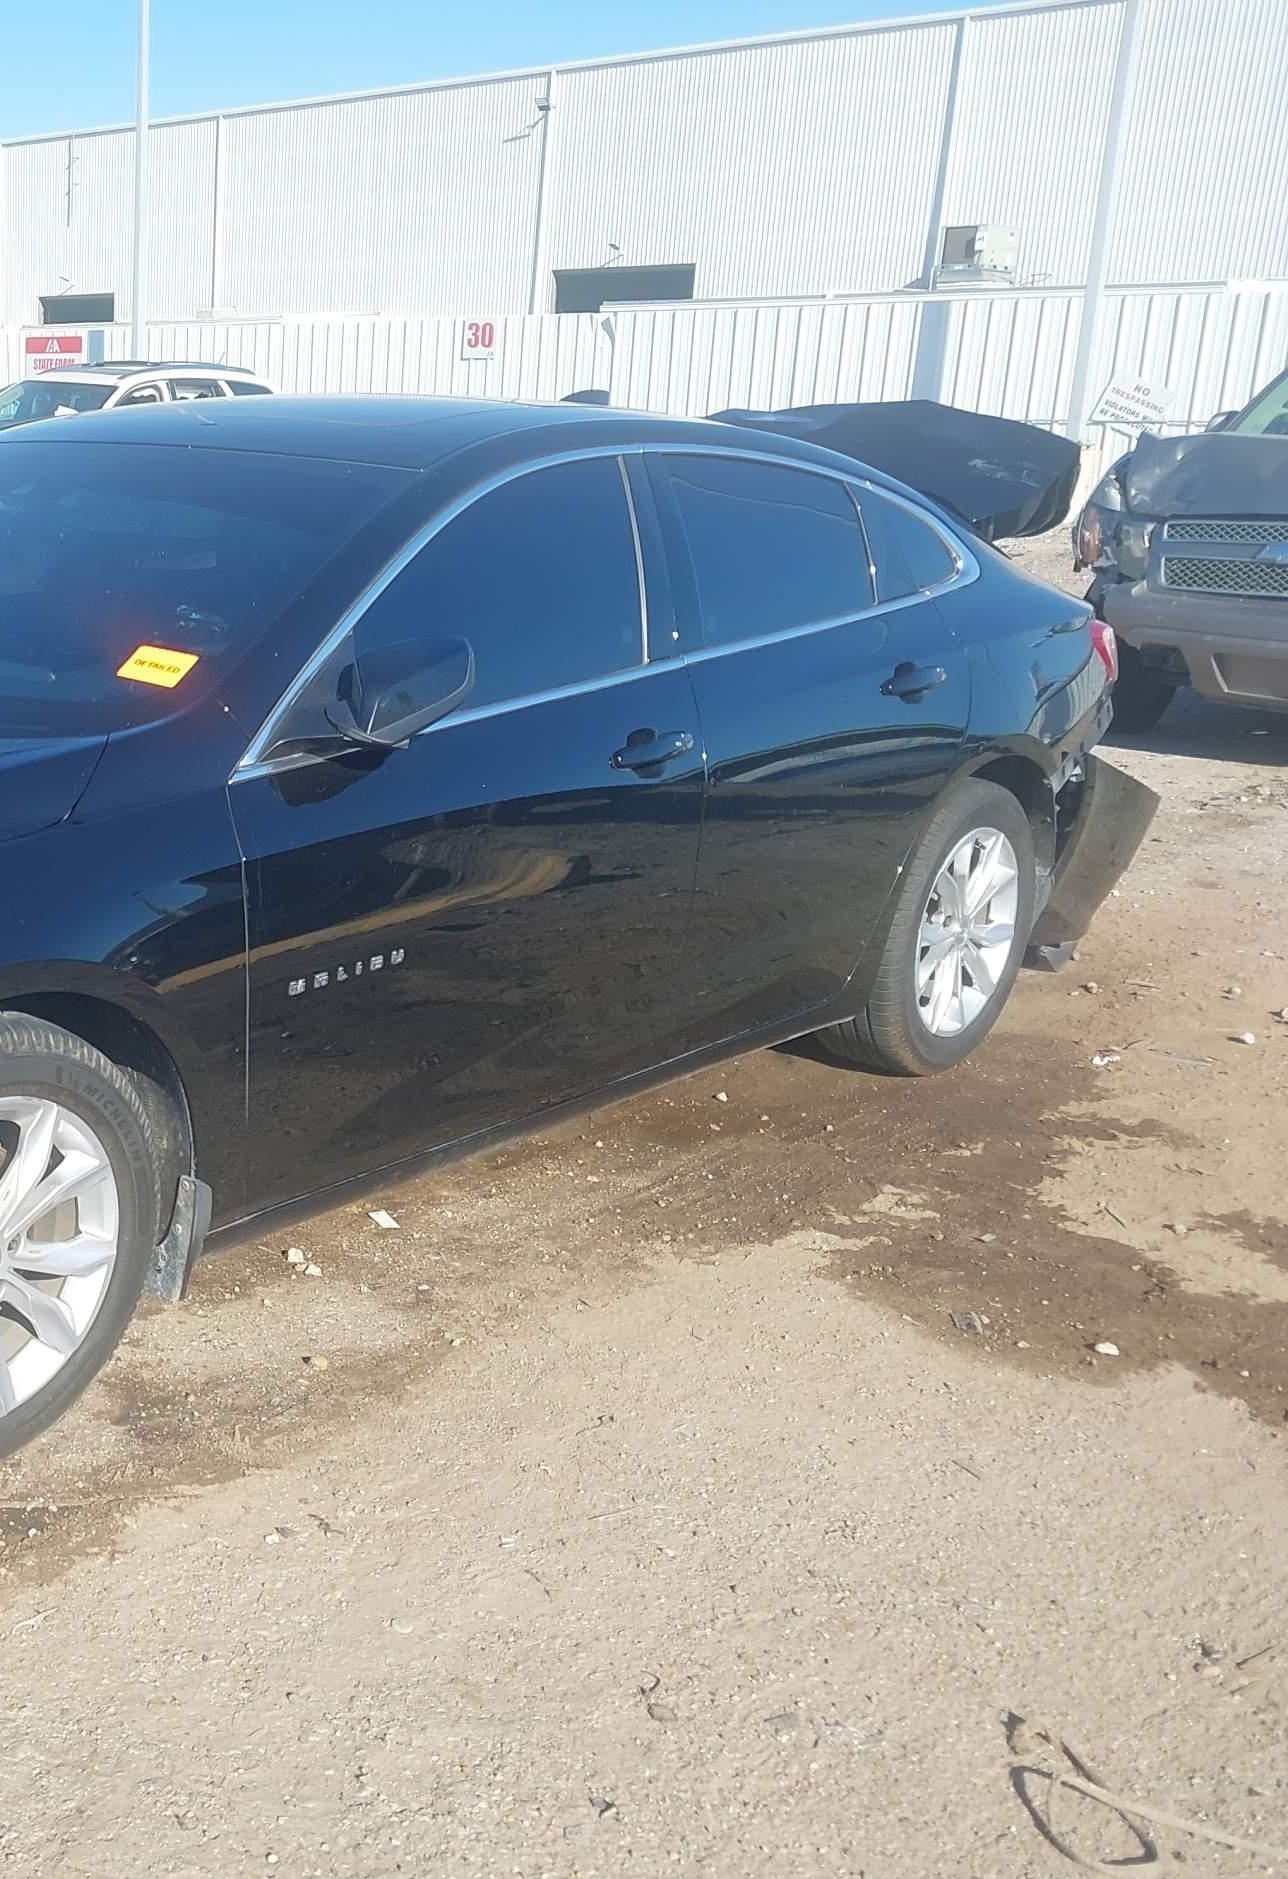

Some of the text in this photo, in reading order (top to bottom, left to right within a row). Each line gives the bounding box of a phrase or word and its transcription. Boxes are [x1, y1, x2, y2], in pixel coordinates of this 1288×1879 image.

[467, 322, 494, 348] 30
[1111, 387, 1165, 414] TRESPASSING
[1133, 384, 1151, 396] NO
[1099, 408, 1110, 416] BE
[1104, 399, 1141, 418] VIOLATORS
[288, 948, 405, 996] MALIBU
[83, 1083, 142, 1162] MICHELIN
